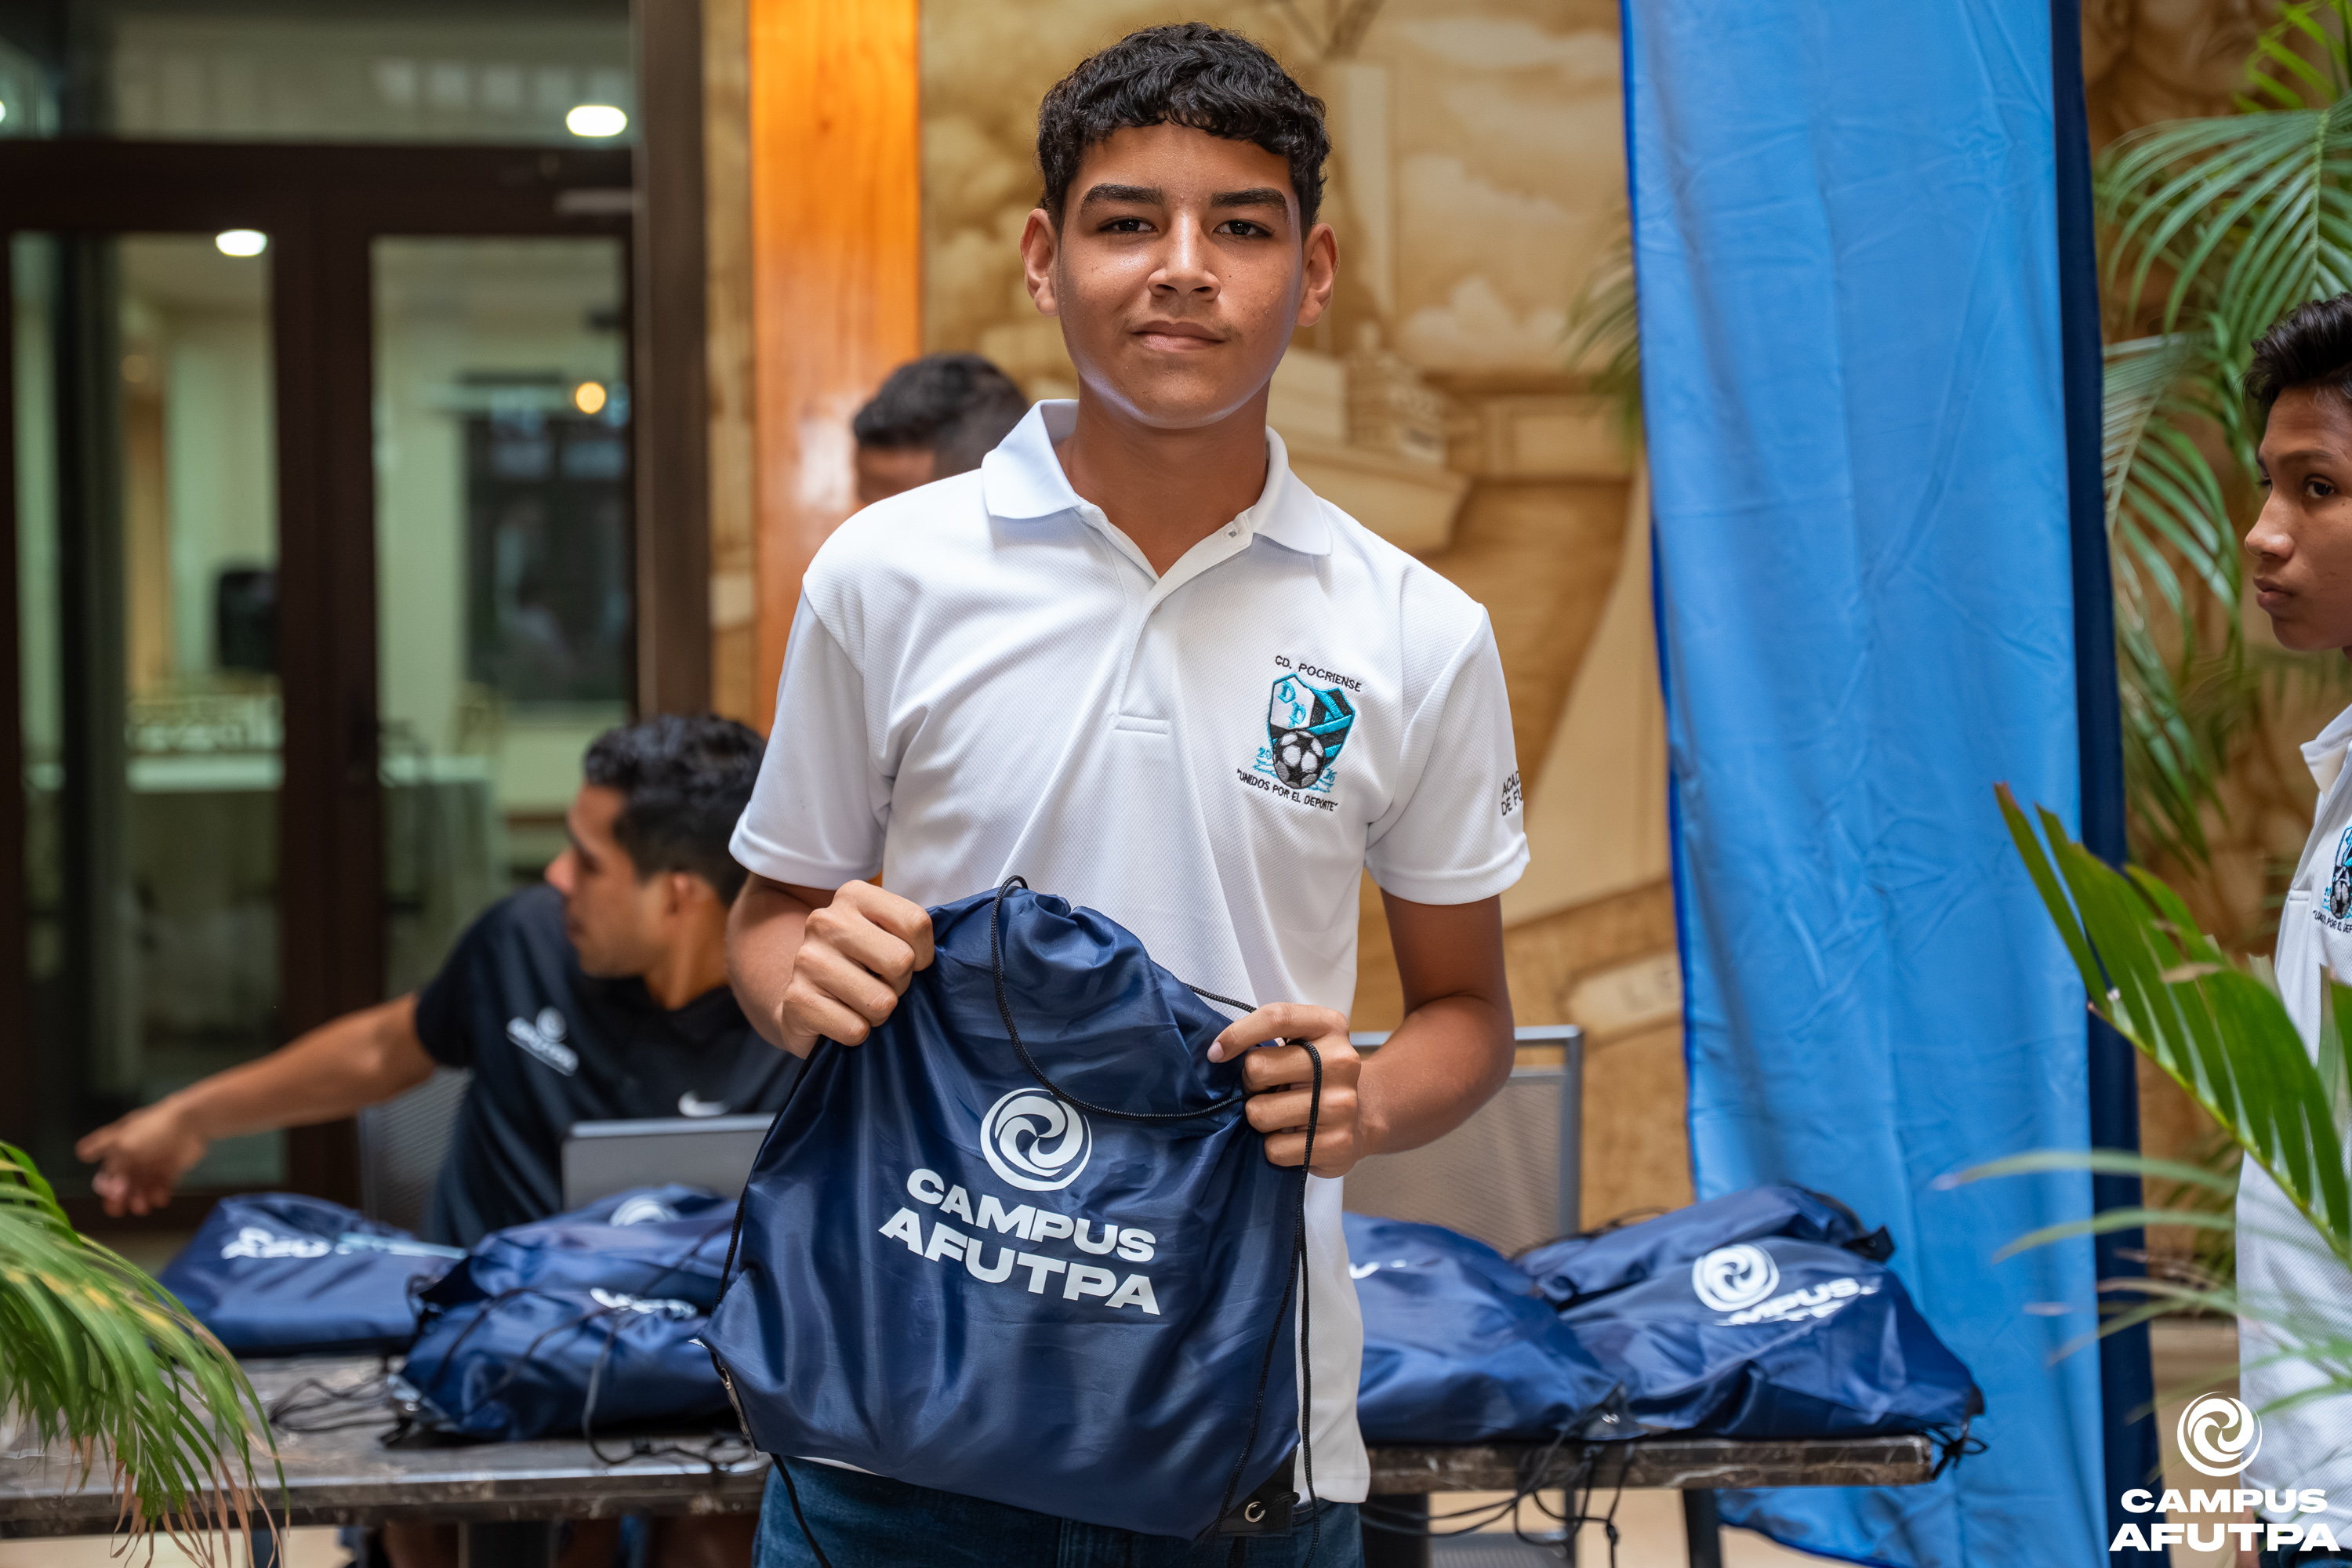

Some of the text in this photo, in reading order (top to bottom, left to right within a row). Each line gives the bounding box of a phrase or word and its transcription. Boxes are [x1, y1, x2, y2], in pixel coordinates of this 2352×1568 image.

[1298, 663, 1362, 692] POCRIENSE
[1272, 785, 1290, 799] POR
[1291, 791, 1301, 803] EL
[1501, 797, 1512, 816] DE
[906, 1168, 1156, 1262] CAMPUS
[878, 1207, 1160, 1315] AFUTPA
